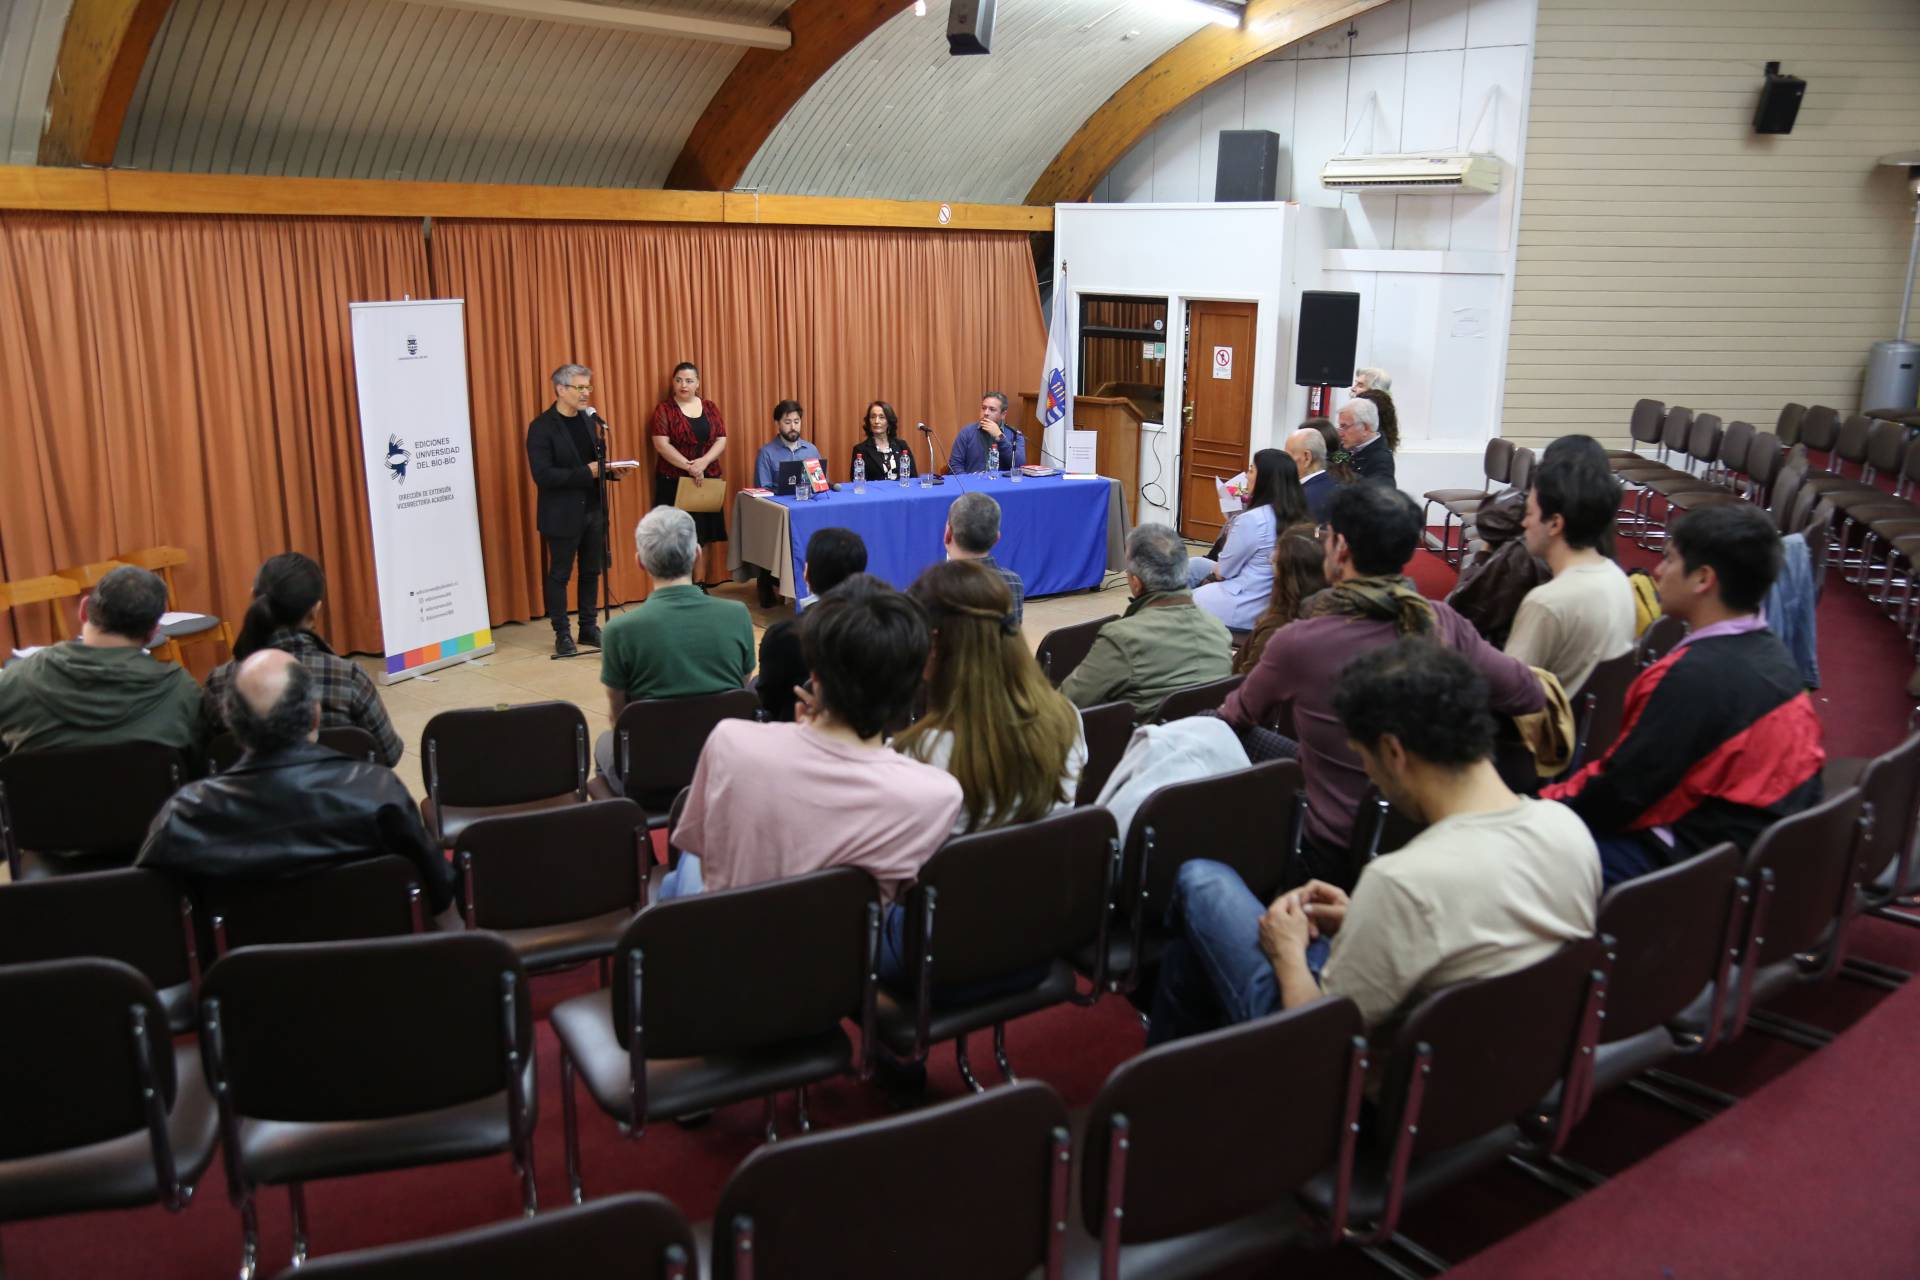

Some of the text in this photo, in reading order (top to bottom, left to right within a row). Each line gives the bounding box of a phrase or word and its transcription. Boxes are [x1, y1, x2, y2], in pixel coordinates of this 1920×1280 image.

[415, 438, 449, 448] EDICIONES
[416, 447, 460, 459] UNIVERSIDAD
[417, 461, 430, 469] DEL
